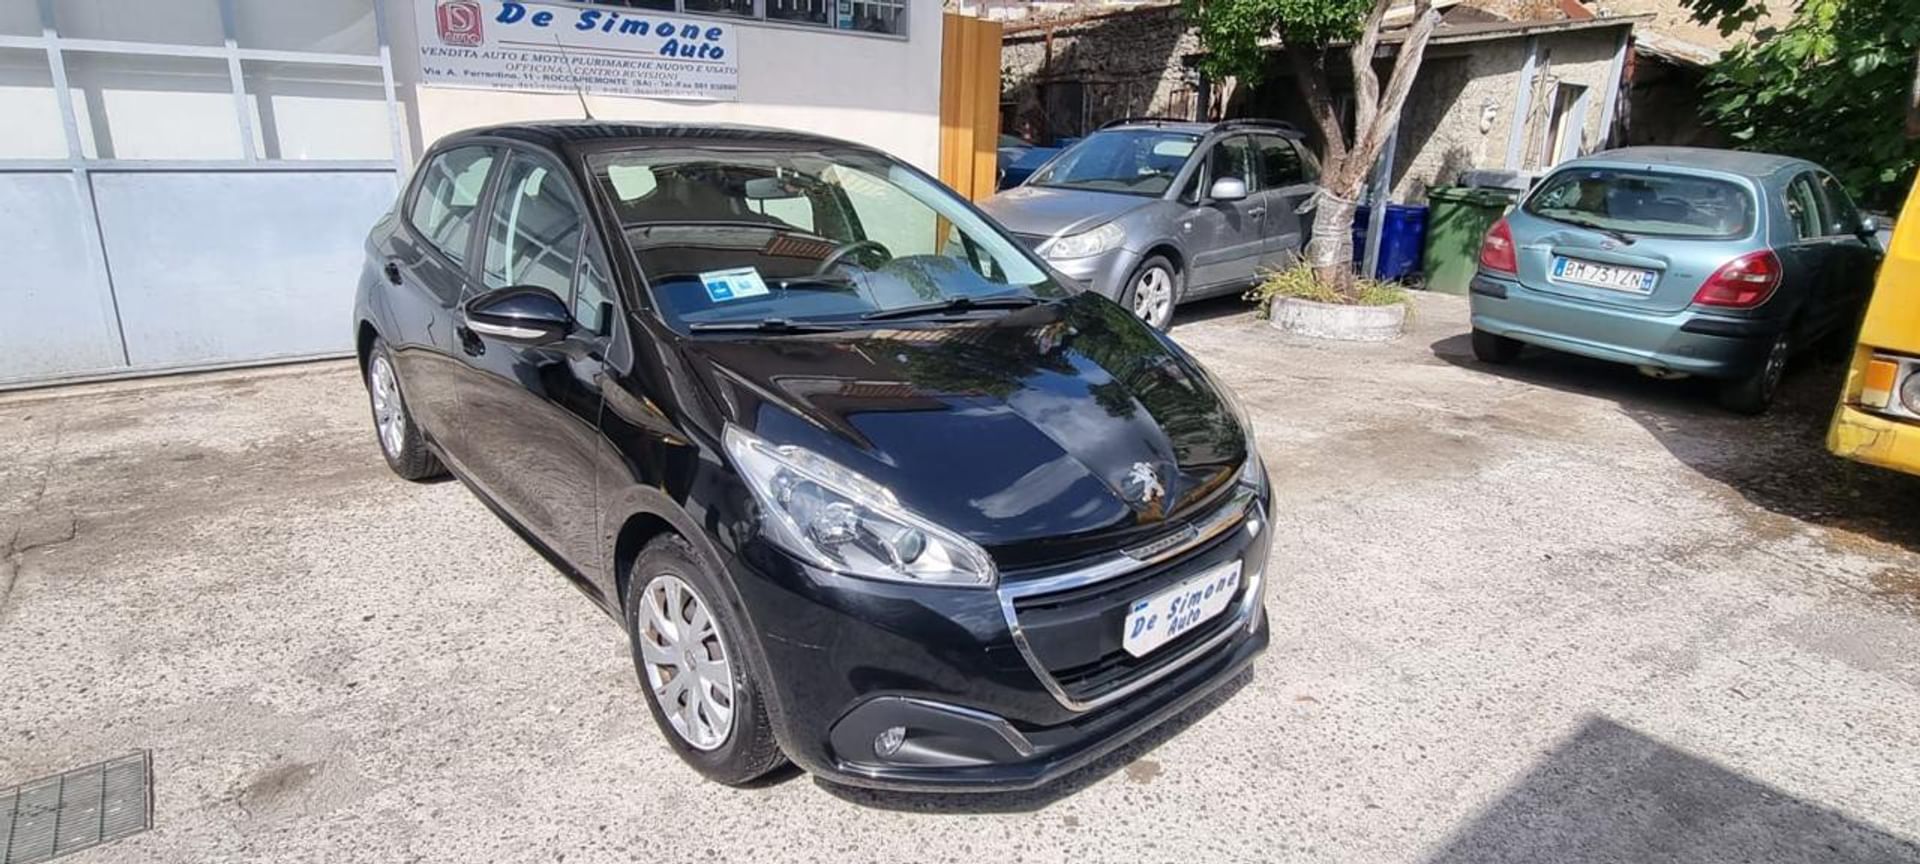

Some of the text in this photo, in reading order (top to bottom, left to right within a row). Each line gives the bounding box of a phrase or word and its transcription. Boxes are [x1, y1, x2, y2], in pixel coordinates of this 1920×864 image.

[495, 2, 723, 42] De Simone
[421, 46, 738, 75] VENDITA AUTO E MOTO PLURIMARCHE NUOVO E USATO
[660, 39, 725, 60] Auto
[424, 66, 441, 76] Via
[505, 62, 563, 74] OFFICINA
[574, 66, 620, 77] CENTRO
[623, 71, 678, 81] REVISIONI
[1565, 262, 1585, 277] BM
[1130, 571, 1238, 639] De Simone
[1167, 607, 1202, 637] Auto
